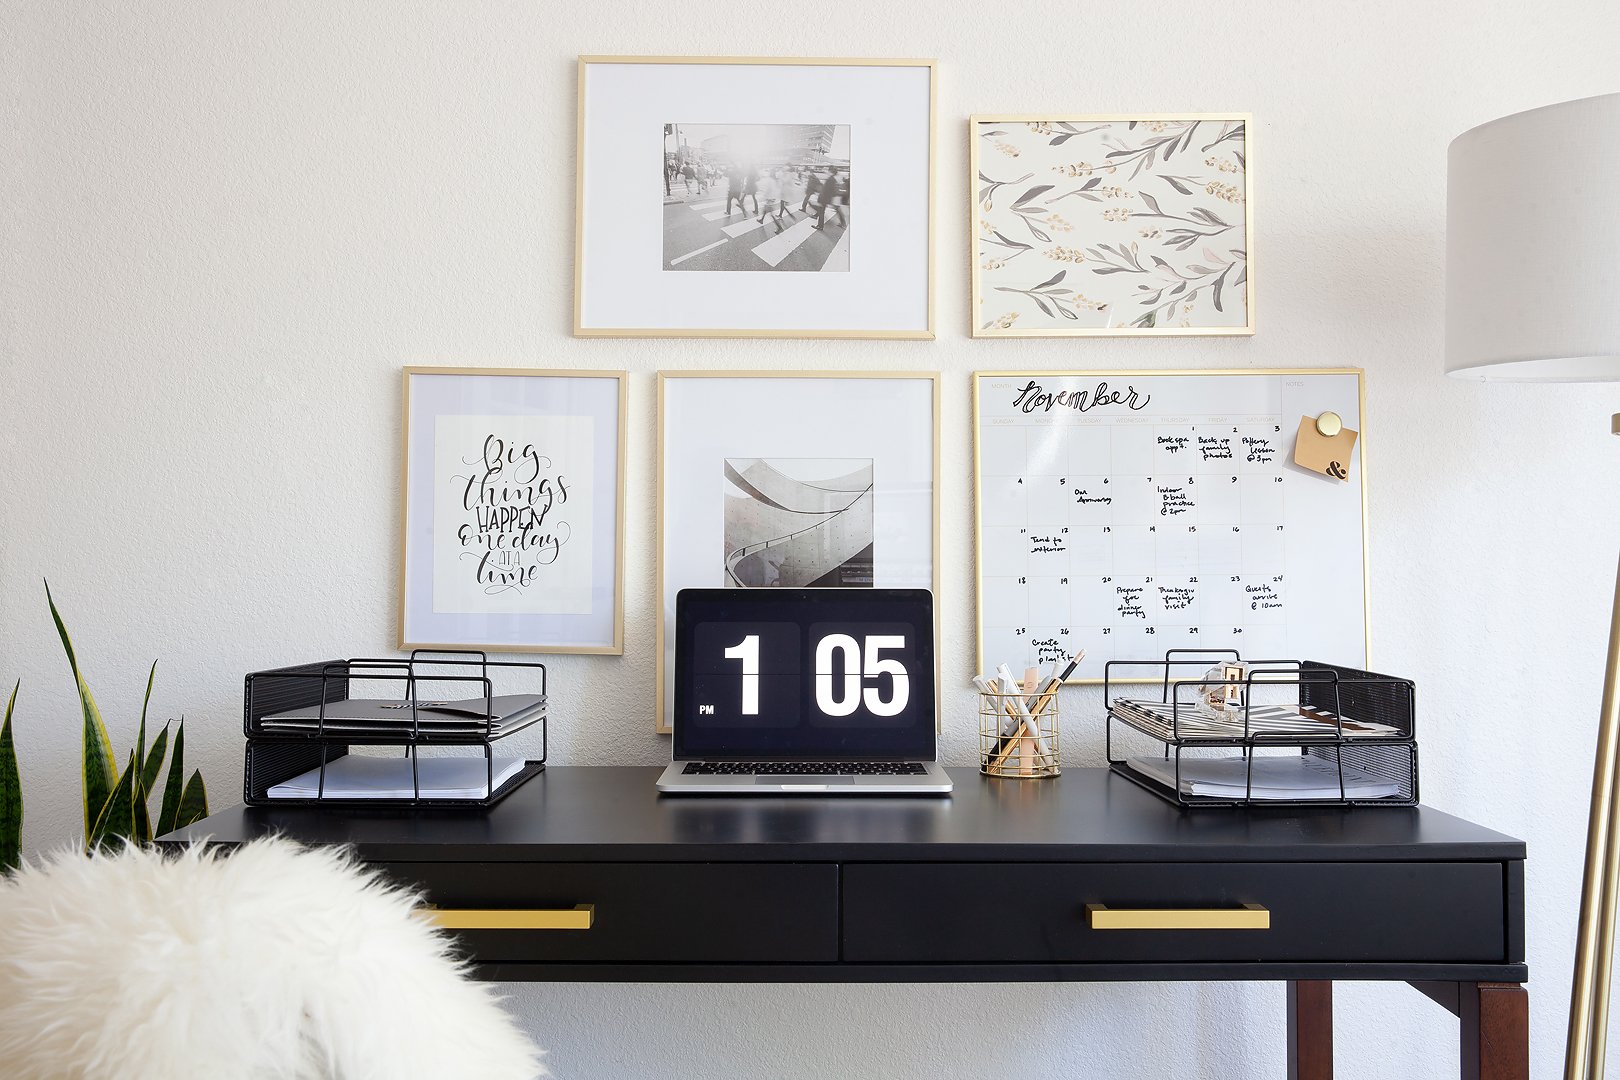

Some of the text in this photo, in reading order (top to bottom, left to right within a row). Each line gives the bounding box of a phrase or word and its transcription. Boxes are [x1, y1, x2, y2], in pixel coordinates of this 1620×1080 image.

[1013, 381, 1151, 413] November
[1220, 438, 1231, 446] up
[1198, 443, 1233, 455] family
[461, 434, 552, 484] Big
[1203, 451, 1233, 461] photos
[1326, 460, 1347, 480] &
[1017, 477, 1023, 485] 4
[1059, 477, 1066, 486] 5
[1103, 477, 1109, 485] 6
[1188, 476, 1194, 485] 8
[1231, 476, 1238, 484] 9
[450, 467, 571, 516] things
[1157, 485, 1183, 494] Indoor
[475, 504, 549, 533] HAPPEN
[1149, 525, 1156, 533] 14
[512, 521, 571, 565] day
[1030, 536, 1063, 547] Tend to
[499, 551, 521, 565] AT A
[459, 551, 538, 595] time
[1018, 576, 1027, 584] 18
[1060, 577, 1068, 585] 19
[1230, 575, 1241, 583] 23
[1272, 574, 1284, 583] 24
[1116, 586, 1144, 596] Prepare
[1122, 594, 1140, 606] for
[1162, 592, 1195, 606] family
[1164, 600, 1187, 611] visit
[1015, 627, 1026, 636] 25
[1060, 627, 1070, 636] 26
[1102, 627, 1111, 635] 27
[1145, 626, 1155, 635] 28
[1031, 638, 1059, 647] Create
[1038, 646, 1066, 657] party
[724, 633, 910, 717] 1 05
[699, 705, 714, 715] PM
